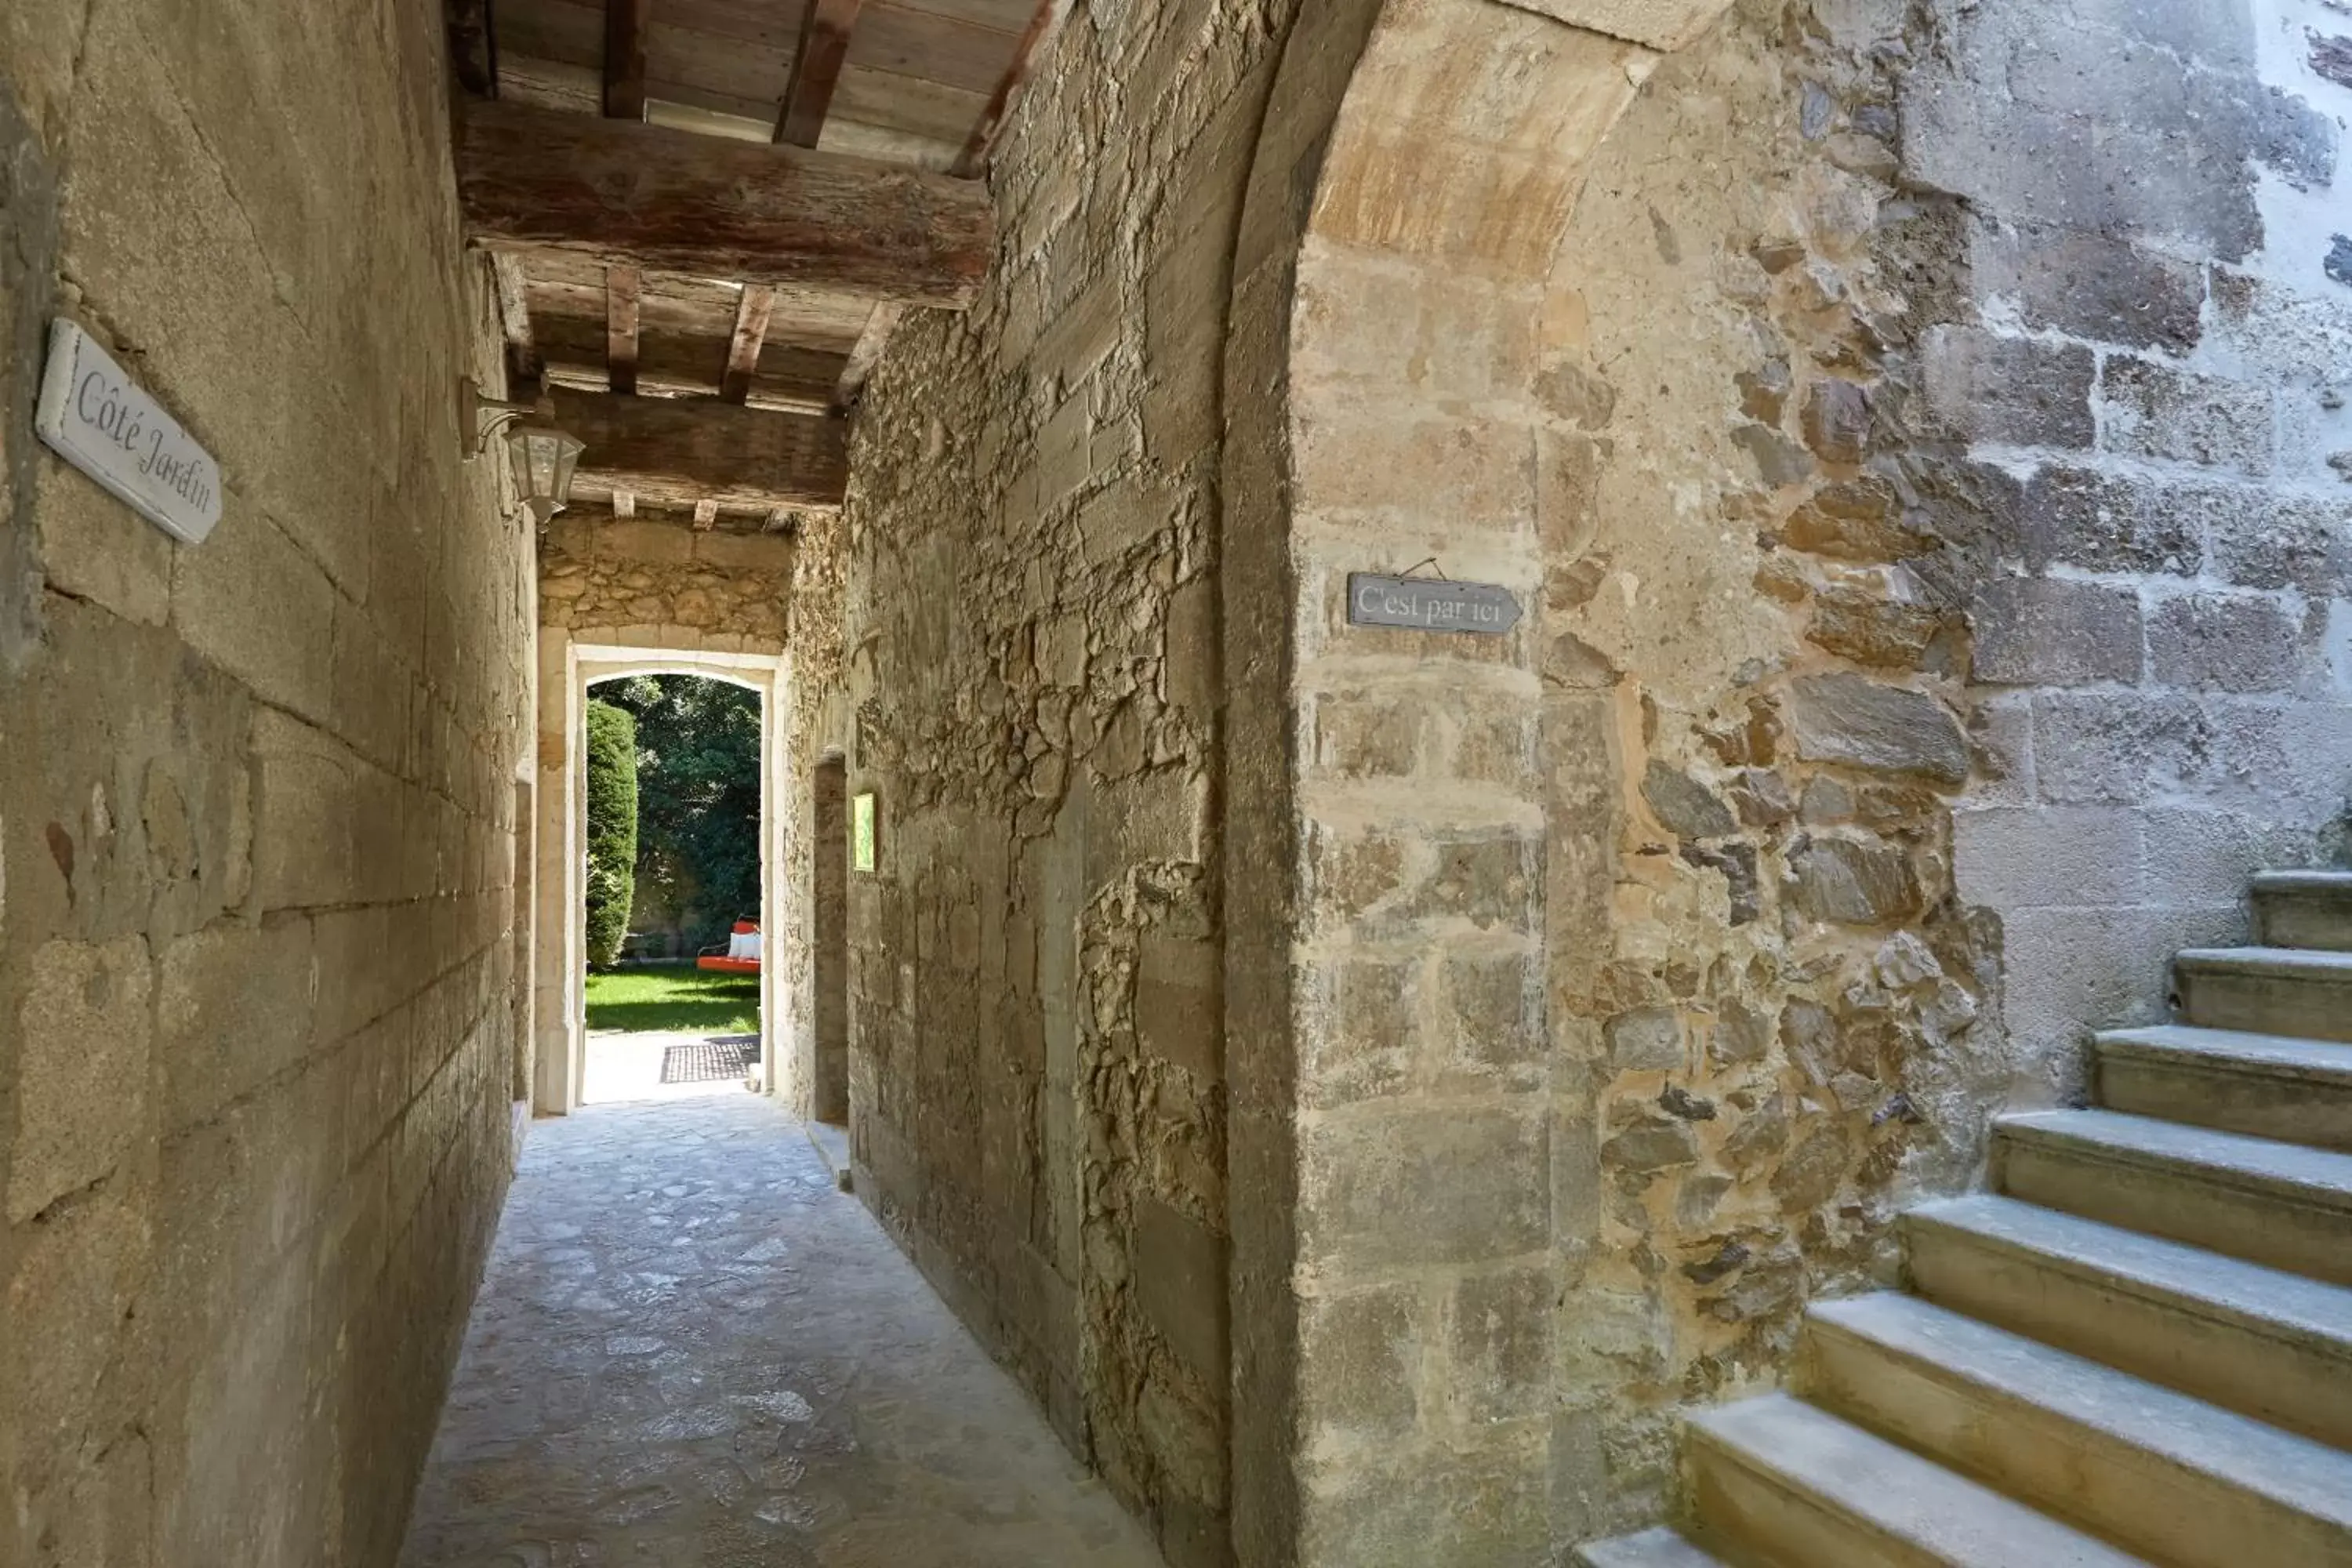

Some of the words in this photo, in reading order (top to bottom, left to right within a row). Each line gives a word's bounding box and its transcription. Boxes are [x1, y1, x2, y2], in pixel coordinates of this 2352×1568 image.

[78, 371, 144, 451] Côté
[139, 429, 211, 514] Jardin
[1358, 586, 1418, 616] C'est
[1427, 599, 1465, 625] par
[1472, 594, 1501, 622] ici
